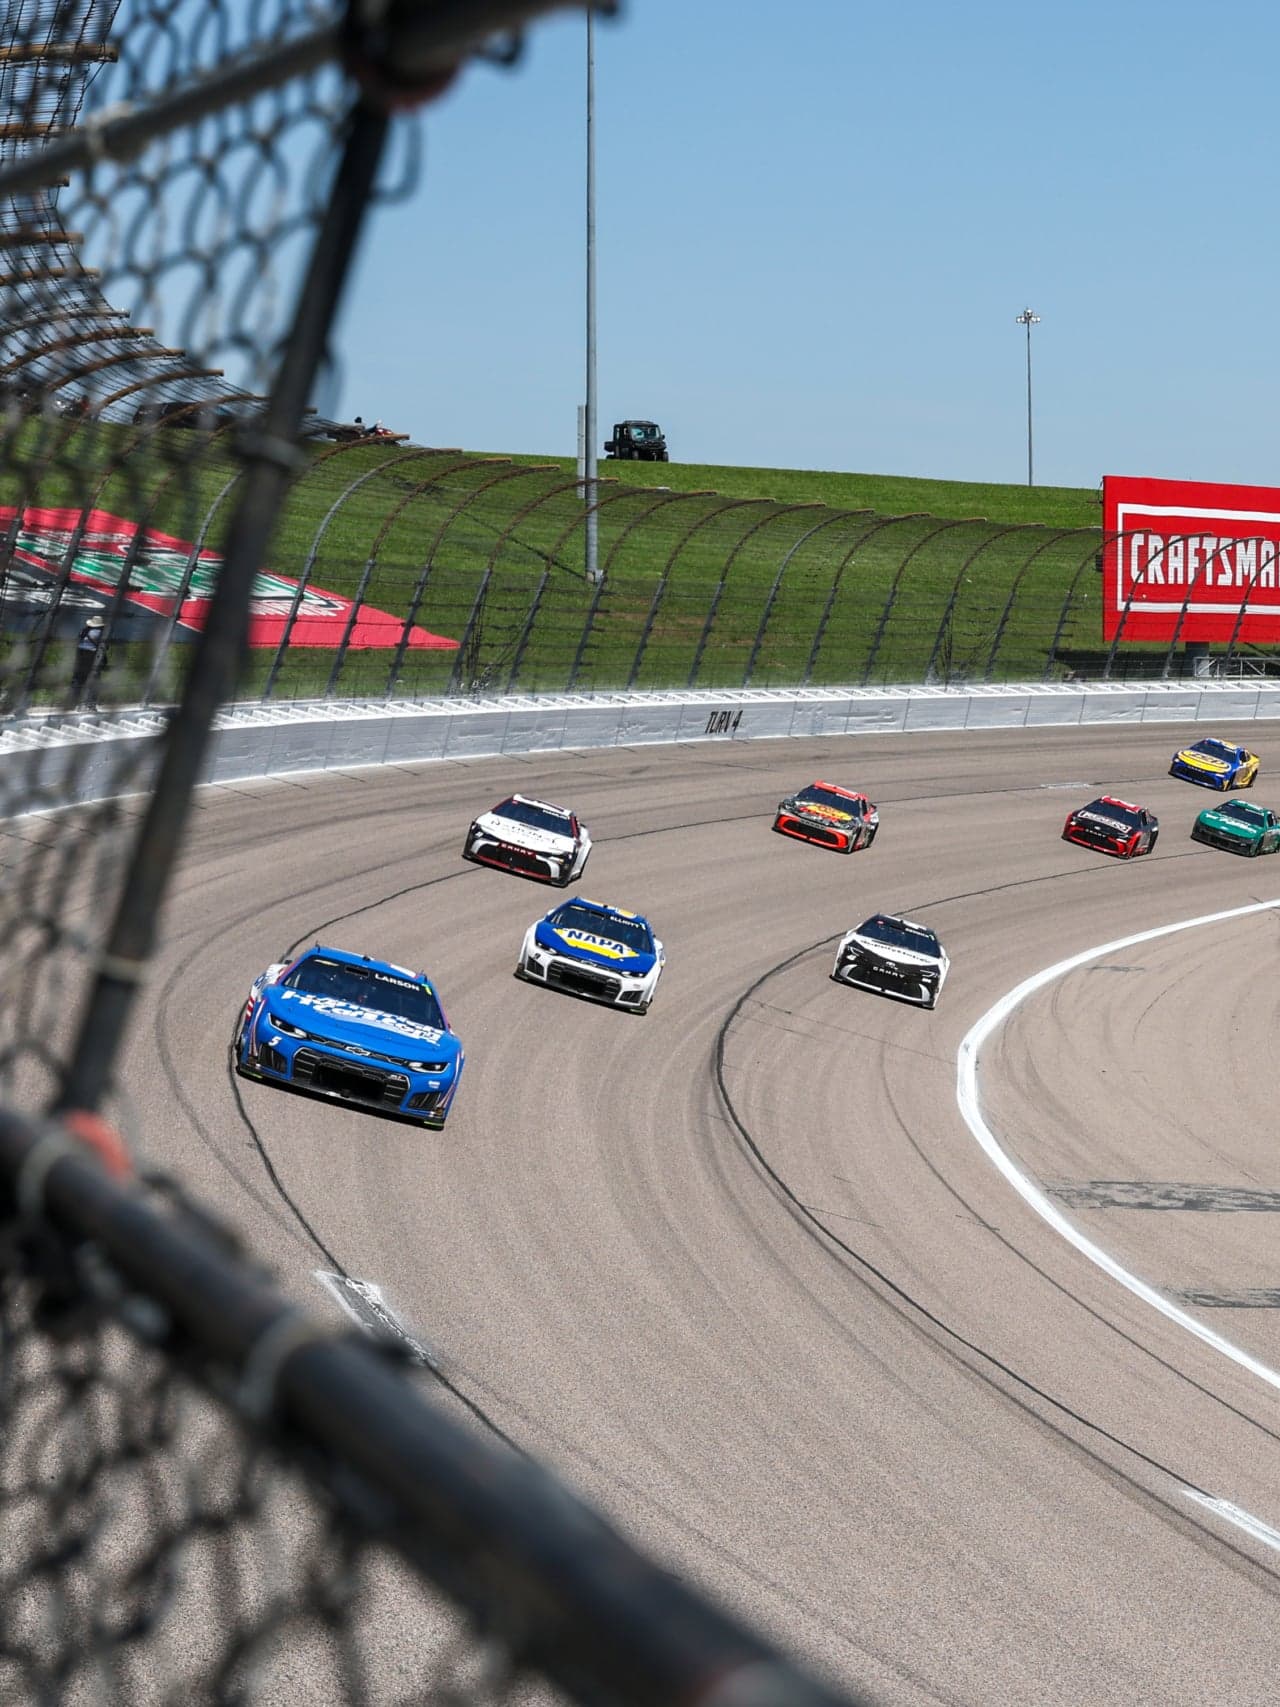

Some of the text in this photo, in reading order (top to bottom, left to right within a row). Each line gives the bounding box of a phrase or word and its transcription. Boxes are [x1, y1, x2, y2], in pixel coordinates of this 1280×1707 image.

[567, 930, 624, 954] NAPA
[374, 973, 420, 991] LARSON
[268, 1036, 282, 1046] 5
